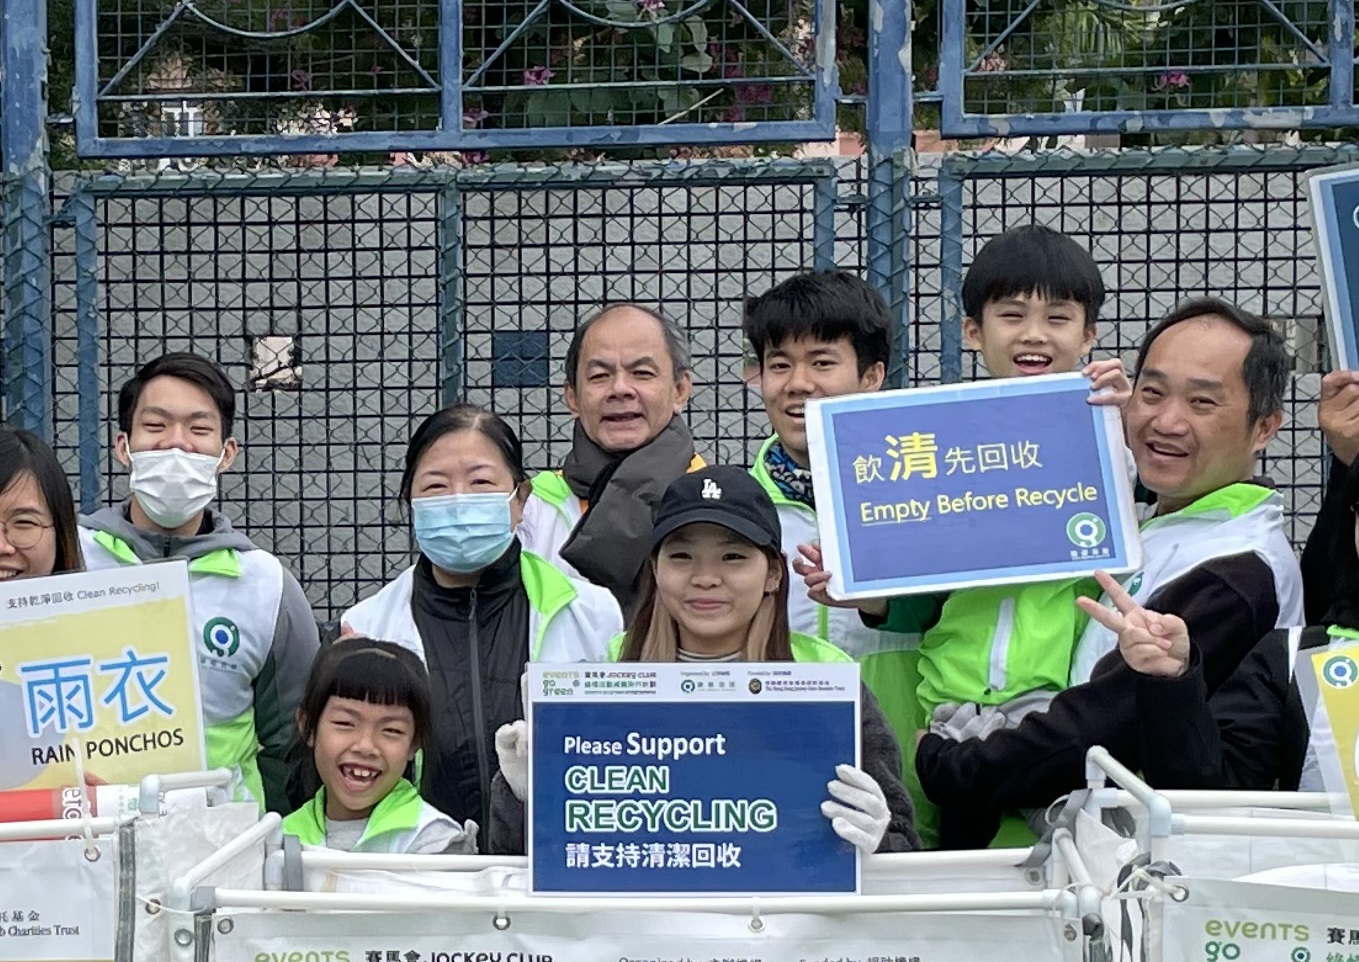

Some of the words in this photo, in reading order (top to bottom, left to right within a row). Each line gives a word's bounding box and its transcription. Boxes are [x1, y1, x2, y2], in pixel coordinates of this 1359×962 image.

[852, 431, 1043, 485] 飲清先回收
[702, 478, 722, 499] LA
[860, 498, 932, 525] Empty
[937, 489, 1009, 516] Before
[1015, 482, 1098, 509] Recycle
[77, 588, 106, 600] Clean
[20, 649, 175, 735] 雨衣
[86, 728, 185, 760] PONCHOS
[563, 735, 623, 755] Please
[626, 732, 726, 760] Support
[565, 766, 670, 794] CLEAN
[565, 800, 778, 832] RECYCLING
[565, 843, 742, 869] 請支持清潔回收
[54, 924, 80, 936] Trust
[1205, 919, 1310, 942] events
[1205, 940, 1241, 962] go
